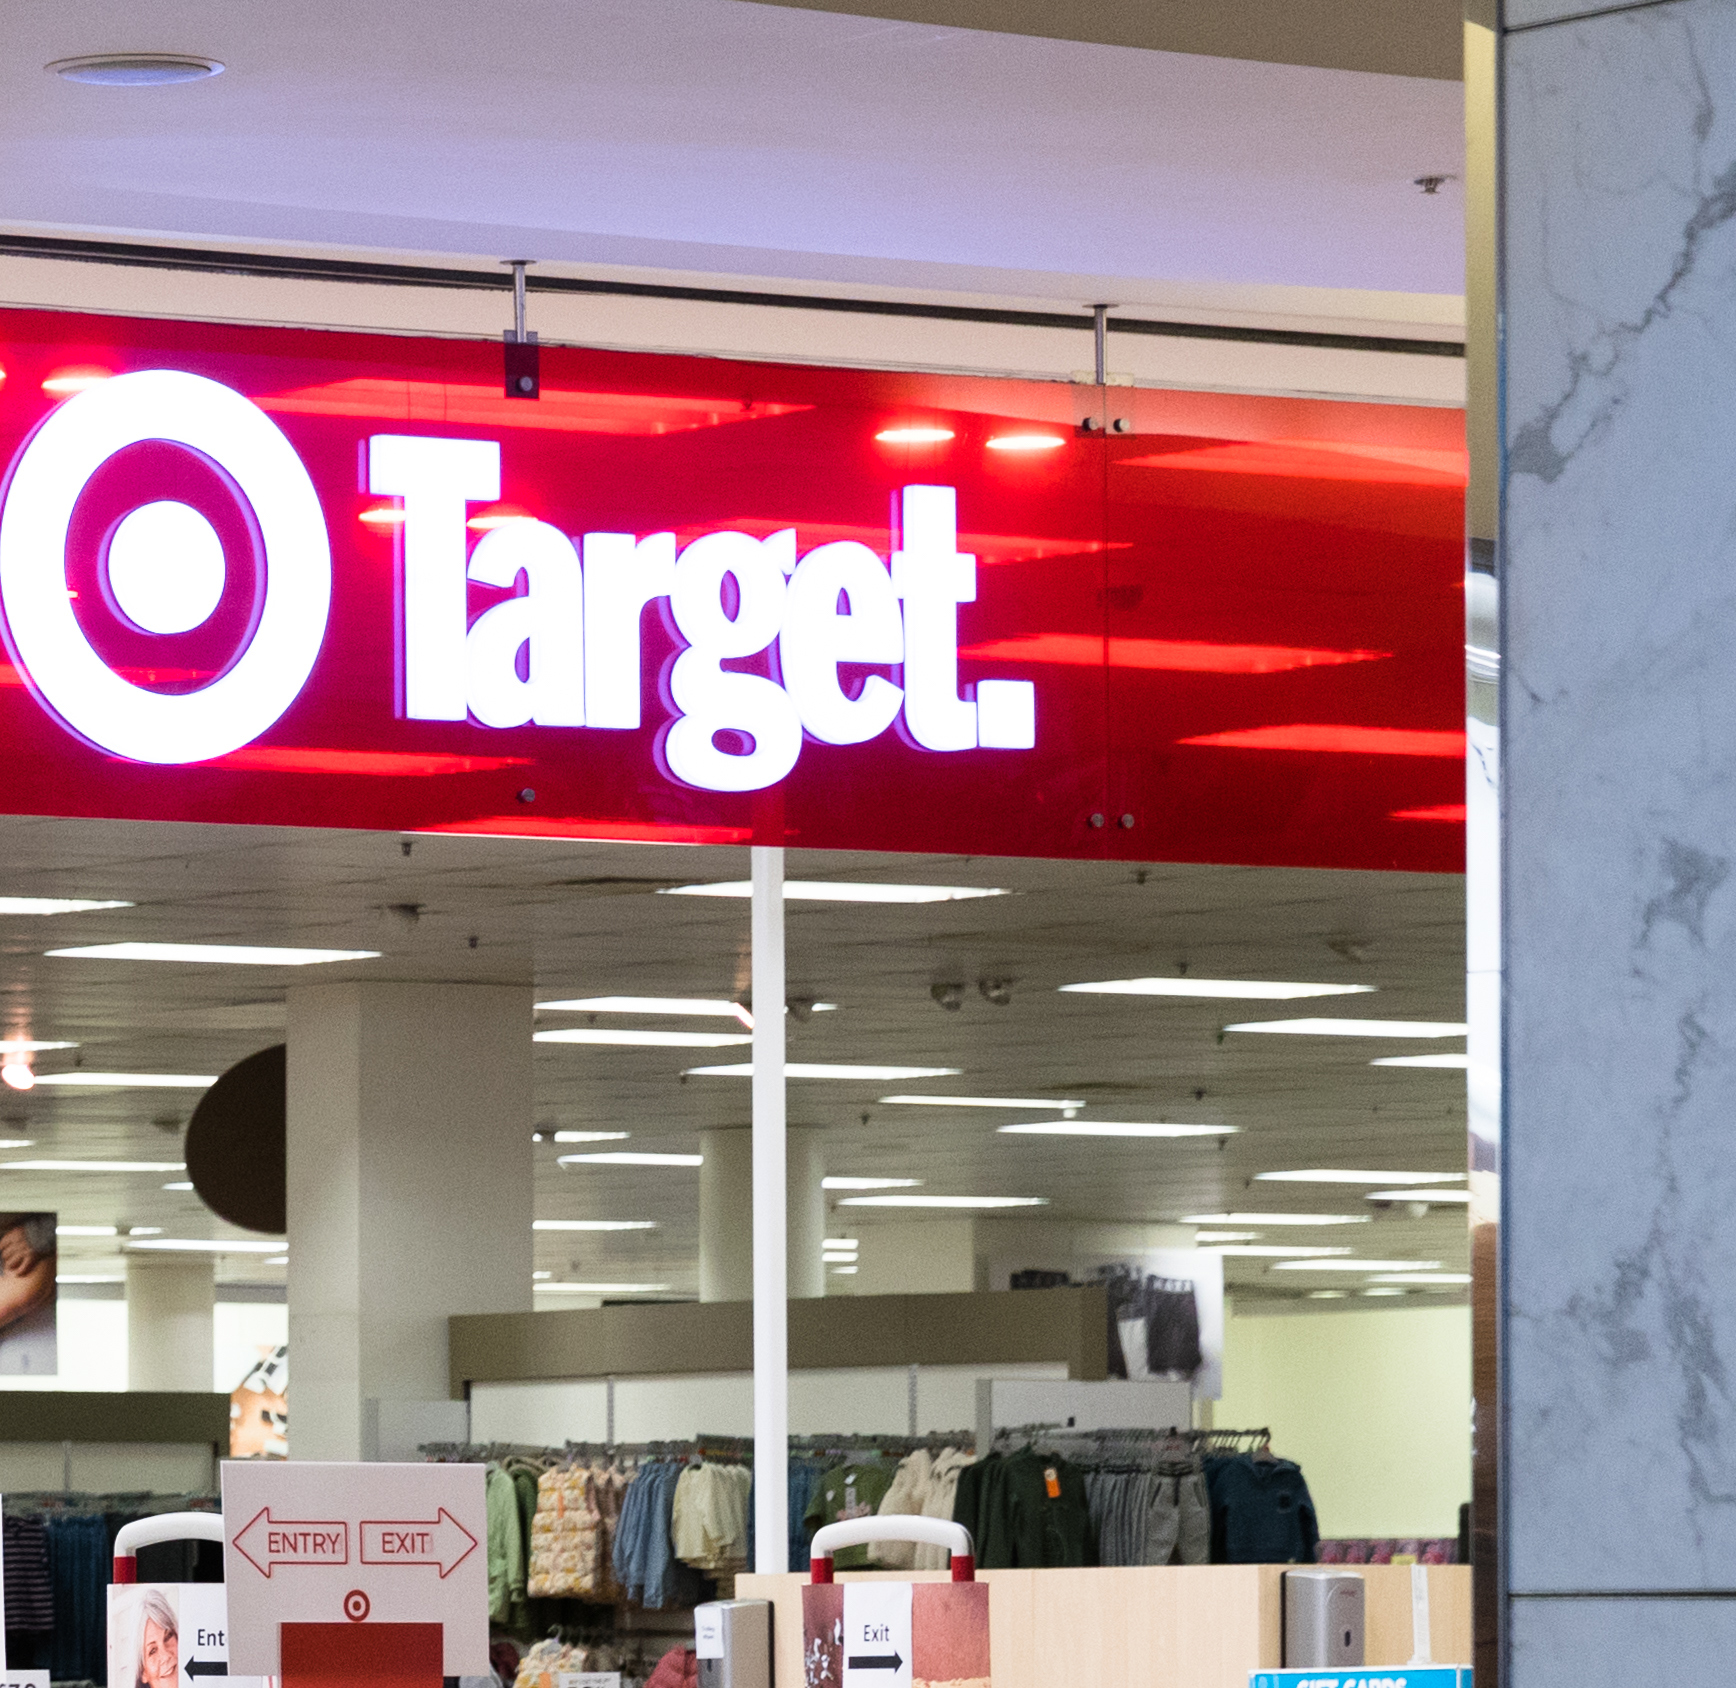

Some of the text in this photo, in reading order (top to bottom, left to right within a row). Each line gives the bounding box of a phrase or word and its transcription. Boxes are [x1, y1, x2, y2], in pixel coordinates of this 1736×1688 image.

[360, 433, 1036, 792] Target.
[268, 1532, 430, 1555] ENTRY EXIT
[197, 1629, 225, 1646] Ent
[863, 1623, 890, 1642] Exit
